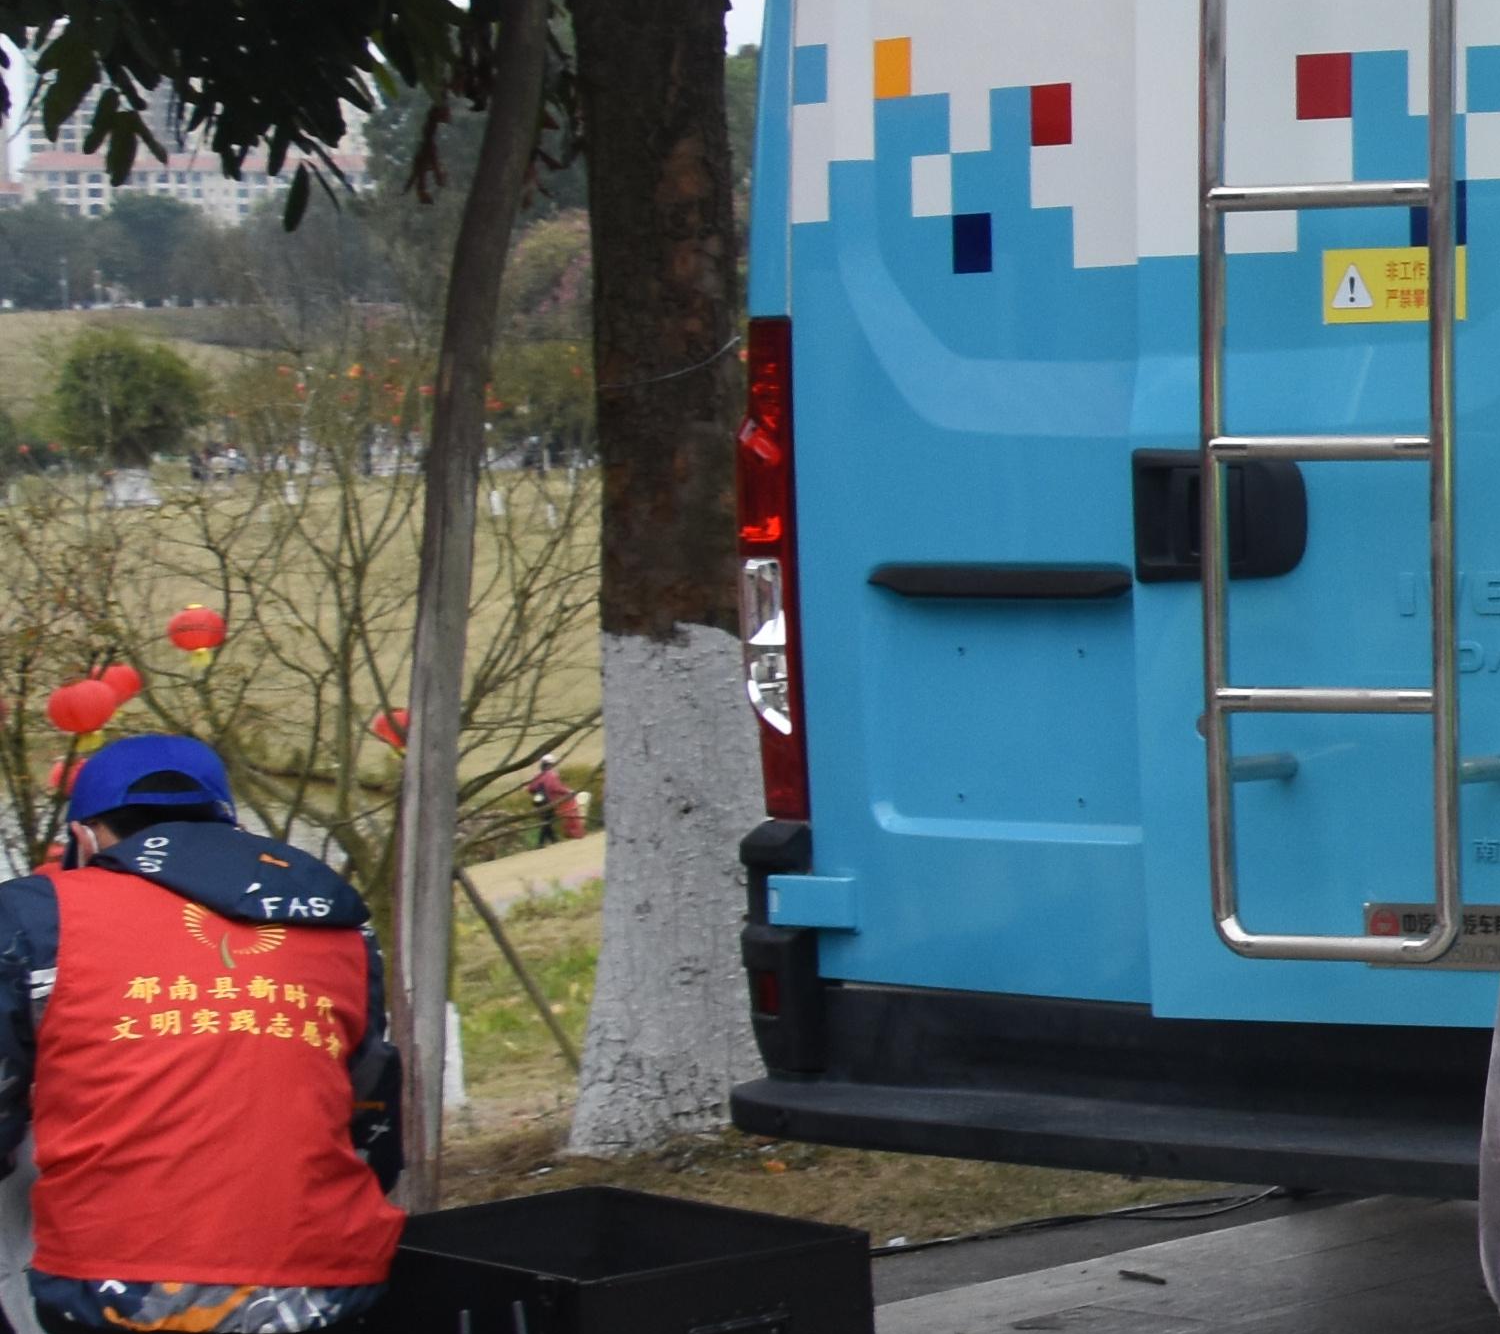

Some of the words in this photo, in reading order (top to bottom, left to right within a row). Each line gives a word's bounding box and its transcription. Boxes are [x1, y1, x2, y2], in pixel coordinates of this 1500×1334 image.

[1385, 261, 1429, 280] 非工作
[1385, 288, 1429, 309] 严禁攀
